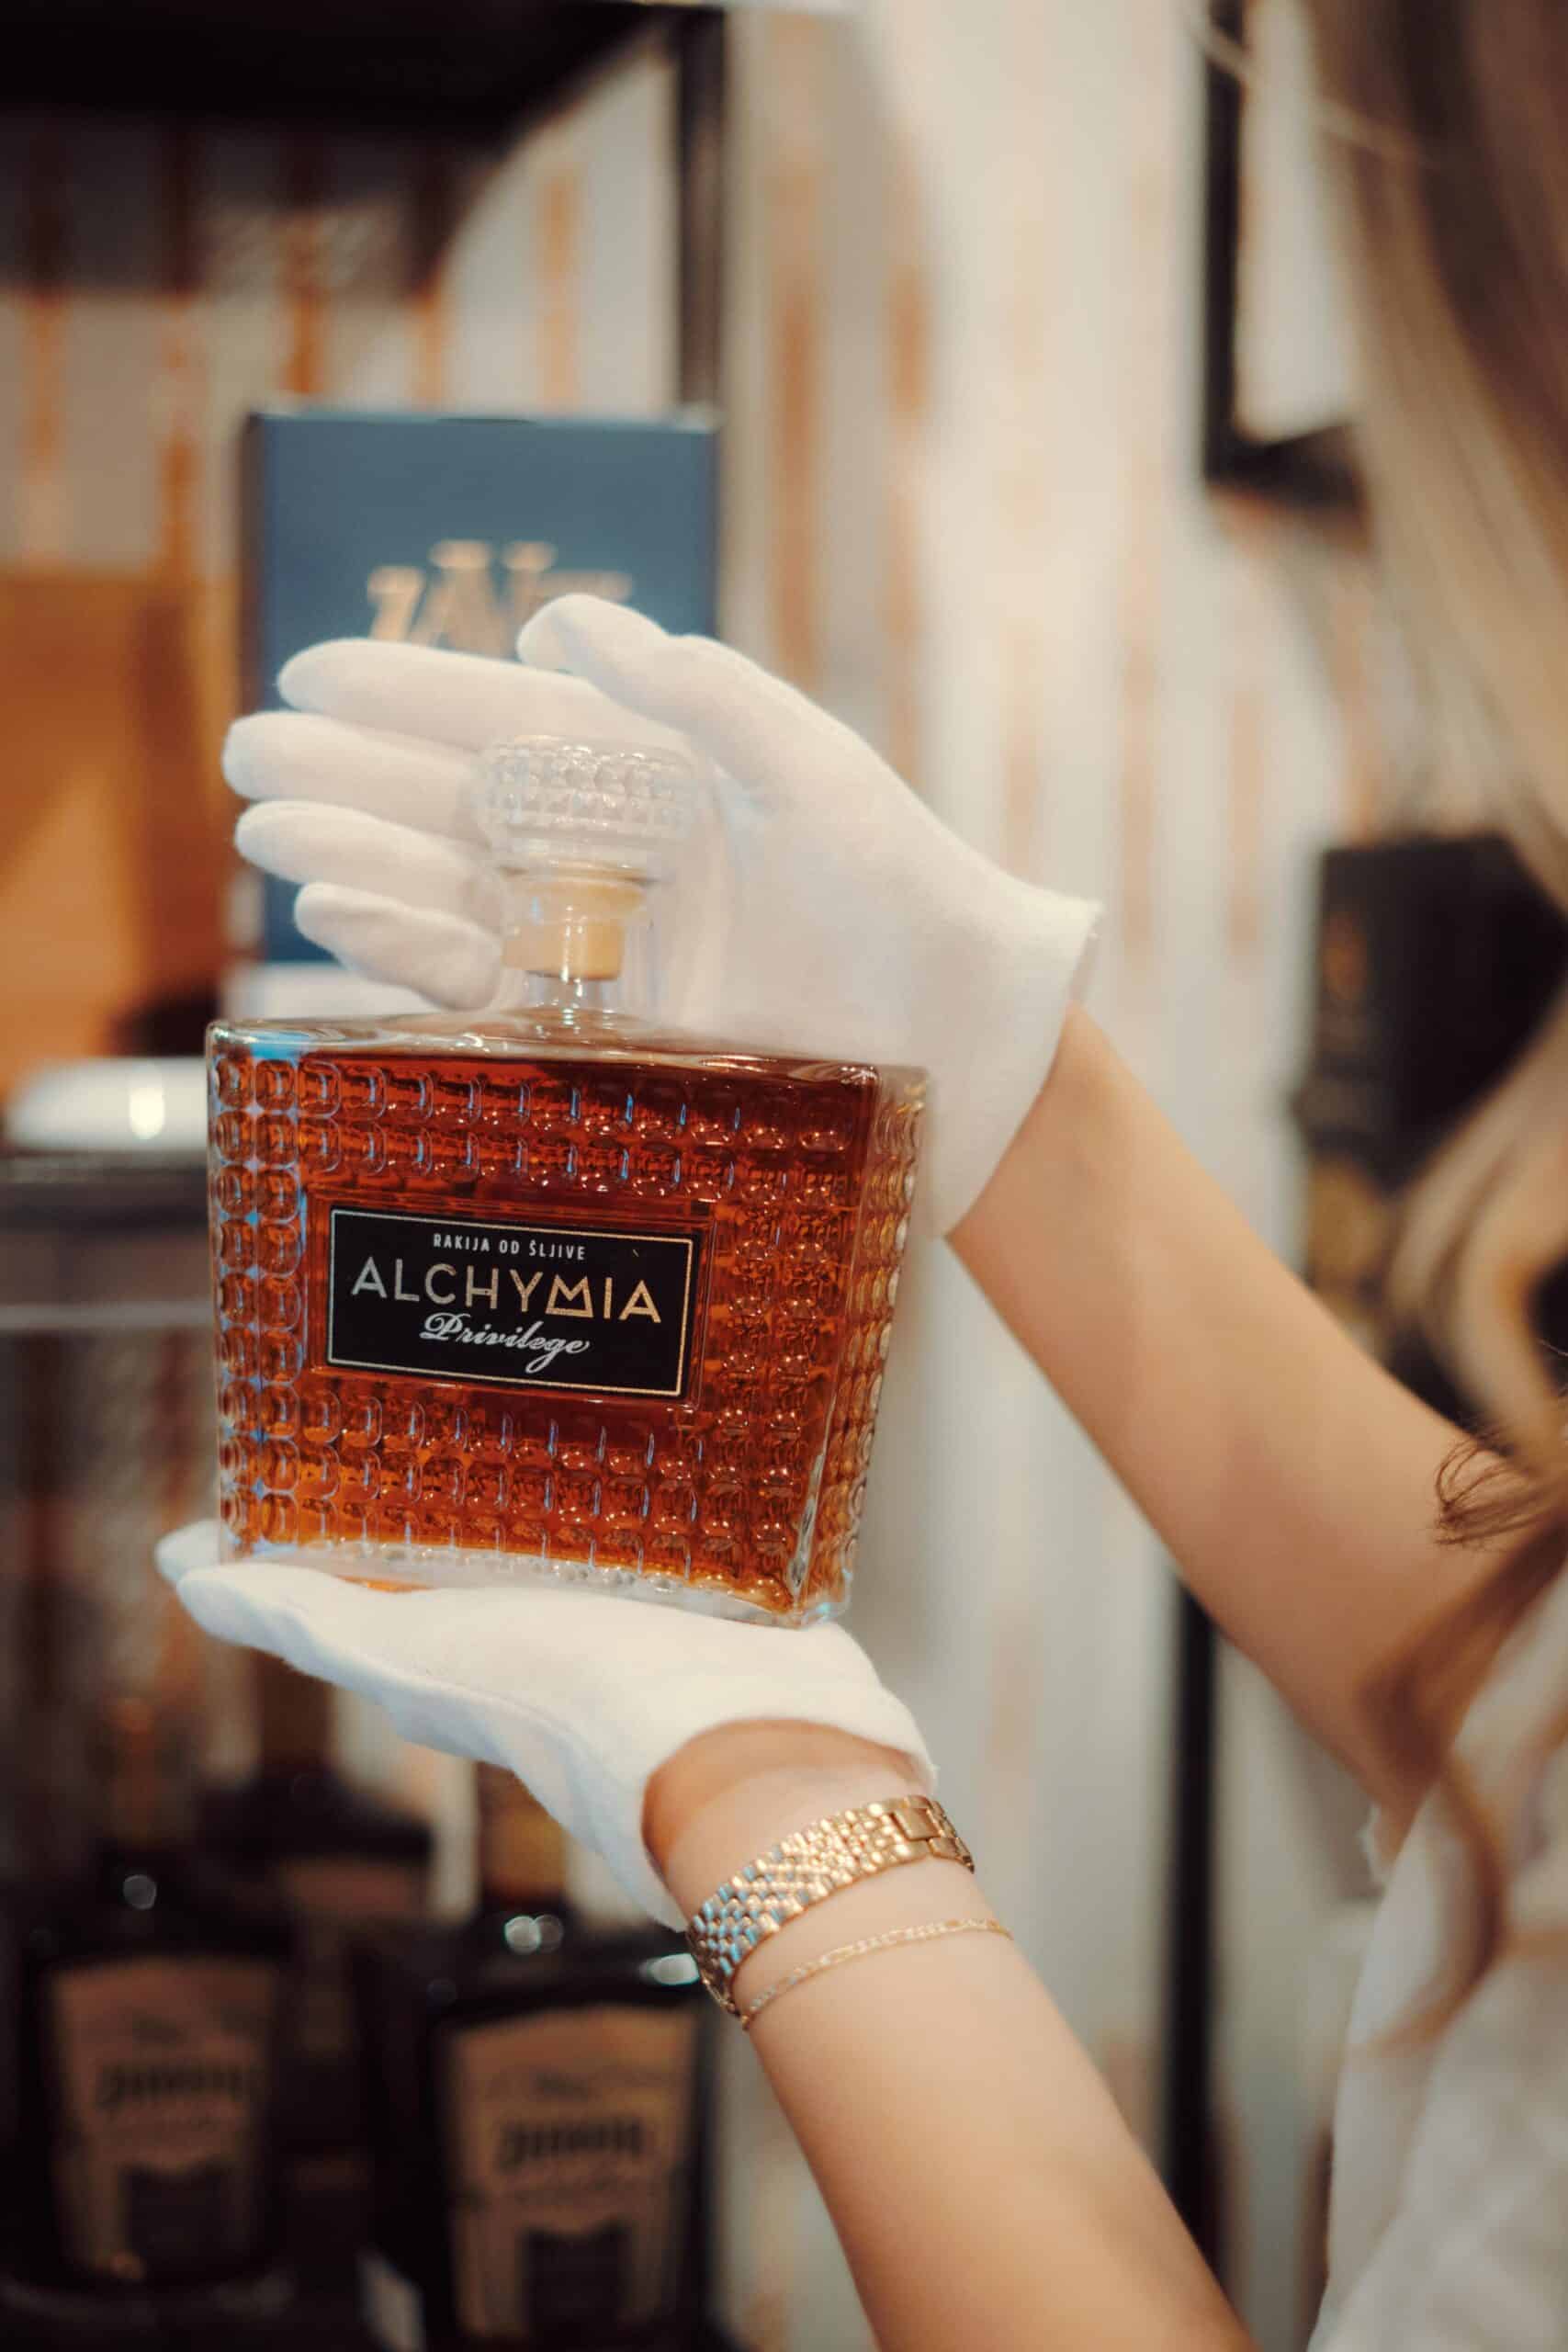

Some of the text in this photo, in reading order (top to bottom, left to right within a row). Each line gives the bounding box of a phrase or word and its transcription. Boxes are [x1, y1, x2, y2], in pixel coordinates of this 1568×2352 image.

[433, 1232, 586, 1261] RAKIJA OD ŠLJIVE
[351, 1256, 662, 1324] ALCHYMIA
[419, 1312, 592, 1374] Privilege
